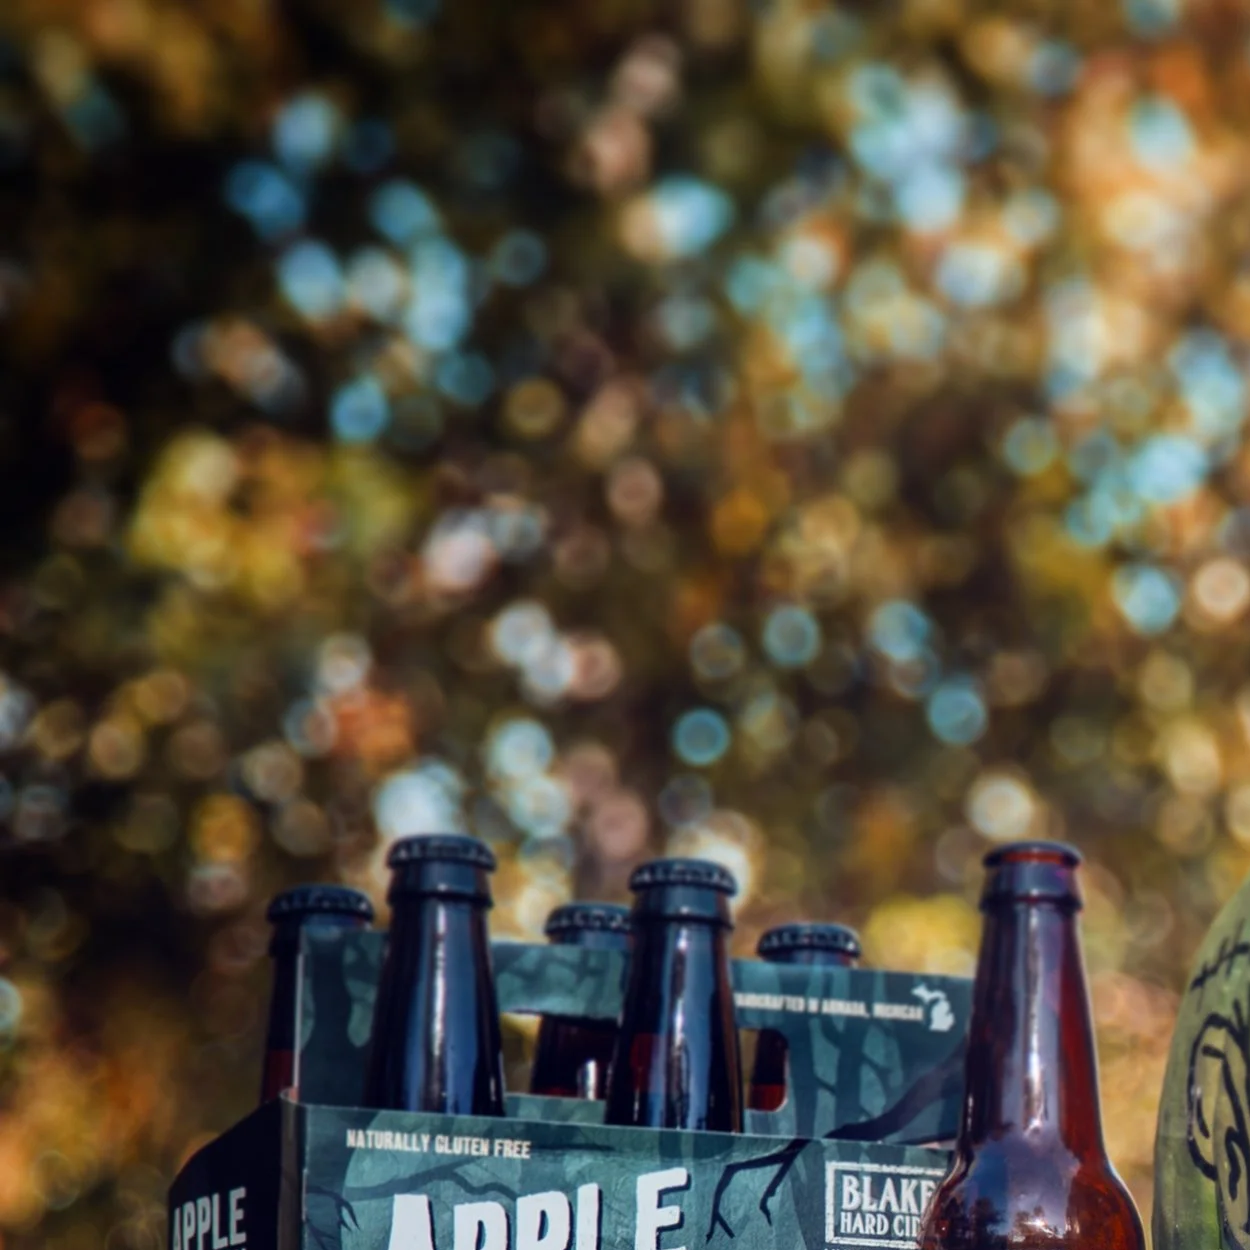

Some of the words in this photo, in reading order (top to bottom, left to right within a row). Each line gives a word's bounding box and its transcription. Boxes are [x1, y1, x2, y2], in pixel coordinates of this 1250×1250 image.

[734, 992, 805, 1012] ANDCRAFTED
[346, 1129, 431, 1153] NATURALLY
[435, 1134, 490, 1156] GLUTEN
[494, 1138, 532, 1160] FREE
[840, 1211, 889, 1236] HARD
